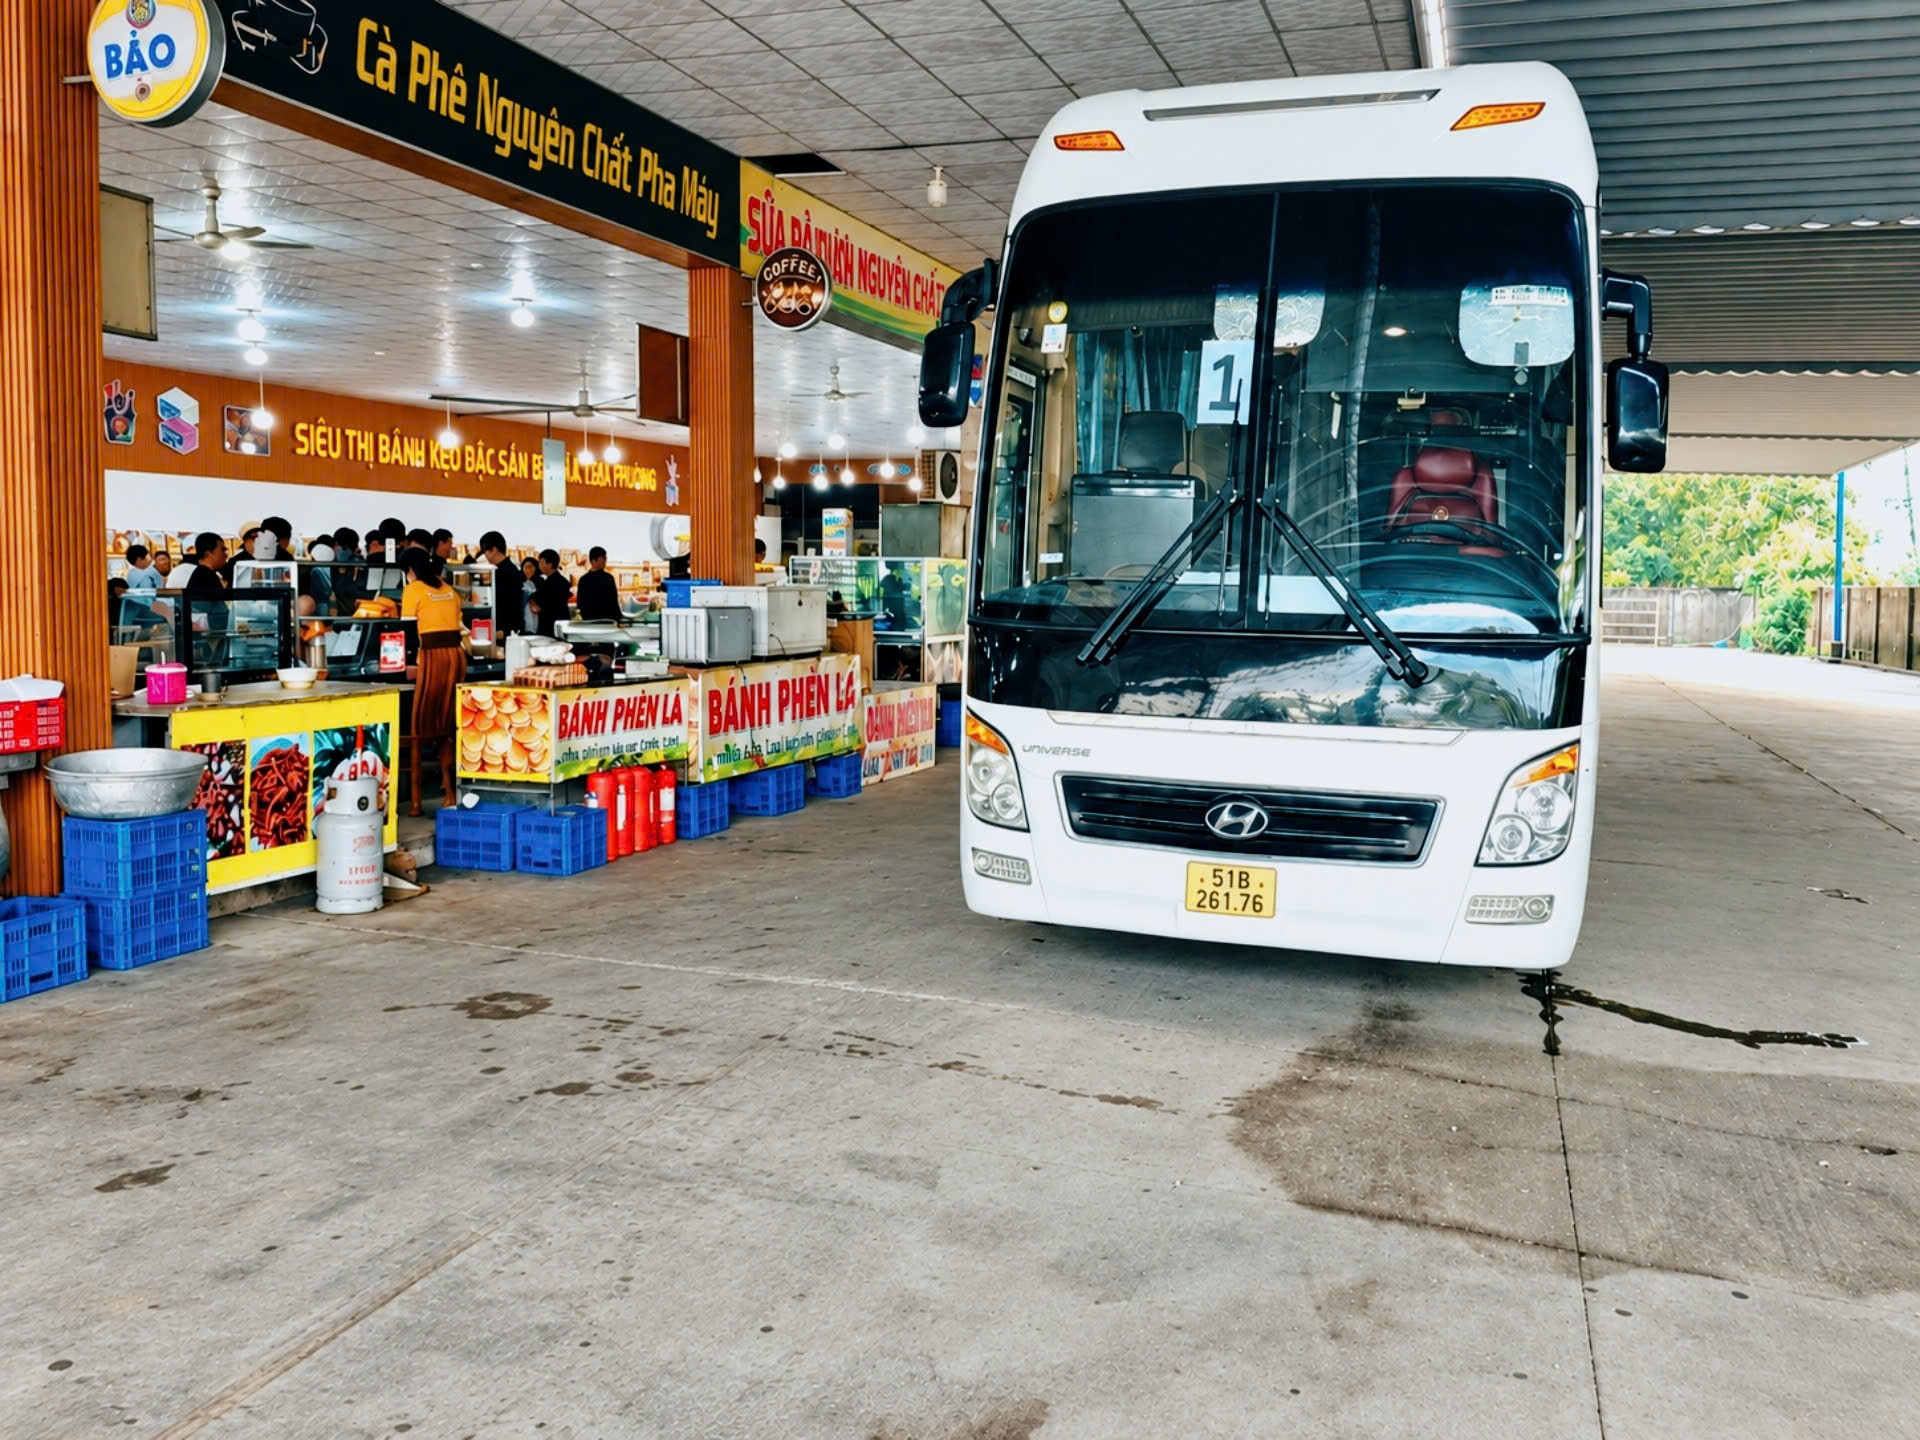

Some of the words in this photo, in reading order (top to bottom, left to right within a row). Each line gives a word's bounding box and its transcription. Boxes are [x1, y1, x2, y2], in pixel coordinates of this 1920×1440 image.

[104, 29, 176, 79] BẢO
[356, 17, 398, 95] Cà
[408, 40, 468, 124] Phê
[475, 72, 576, 172] Nguyên
[581, 122, 633, 193] Chất
[637, 147, 676, 211] Pha
[680, 165, 720, 240] Máy
[1209, 354, 1238, 411] 1
[295, 416, 342, 459] SIÊU
[345, 429, 375, 469] THỊ
[558, 694, 609, 740] BÁNH
[708, 676, 772, 736] BÁNH
[1022, 744, 1092, 758] UNIVERSE
[1196, 889, 1264, 913] 261.76
[1212, 868, 1250, 889] 51B
